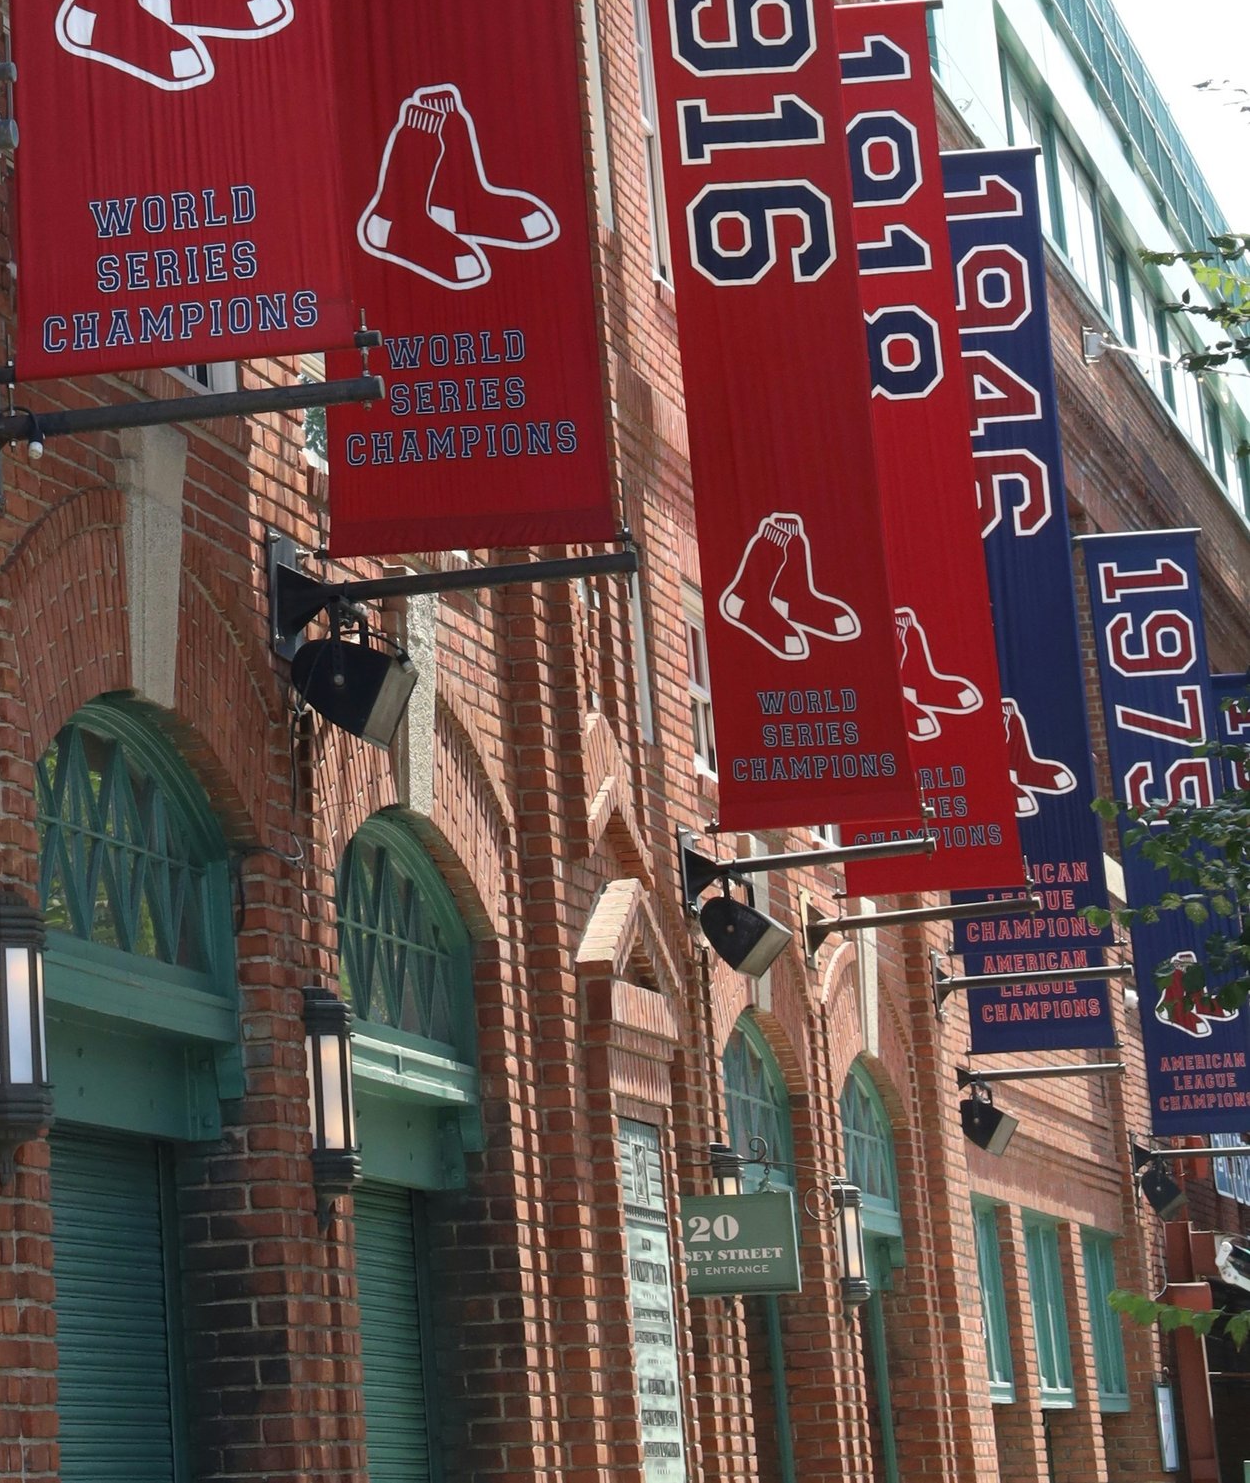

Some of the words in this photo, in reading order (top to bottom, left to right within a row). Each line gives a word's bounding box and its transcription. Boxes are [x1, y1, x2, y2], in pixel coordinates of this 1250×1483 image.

[89, 185, 257, 239] WORLD
[96, 240, 258, 293] SERIES
[42, 290, 318, 353] CHAMPIONS
[385, 329, 526, 370] WORLD
[390, 376, 526, 416] SERIES
[346, 421, 578, 466] CHAMPIONS
[757, 688, 857, 715] WORLD
[1098, 558, 1215, 826] 1975
[762, 721, 859, 747] SERIES
[732, 753, 896, 781] CHAMPIONS
[919, 765, 966, 789] RLD
[1031, 862, 1089, 884] ICAN
[983, 950, 1088, 974] AMERICAN
[981, 998, 1100, 1023] CHAMPIONS
[1160, 1052, 1246, 1072] AMERICAN
[1173, 1072, 1237, 1091] LEAGUE
[687, 1214, 739, 1242] 20
[684, 1249, 714, 1263] SEY
[717, 1247, 783, 1261] STREET
[705, 1264, 770, 1276] ENTRANCE
